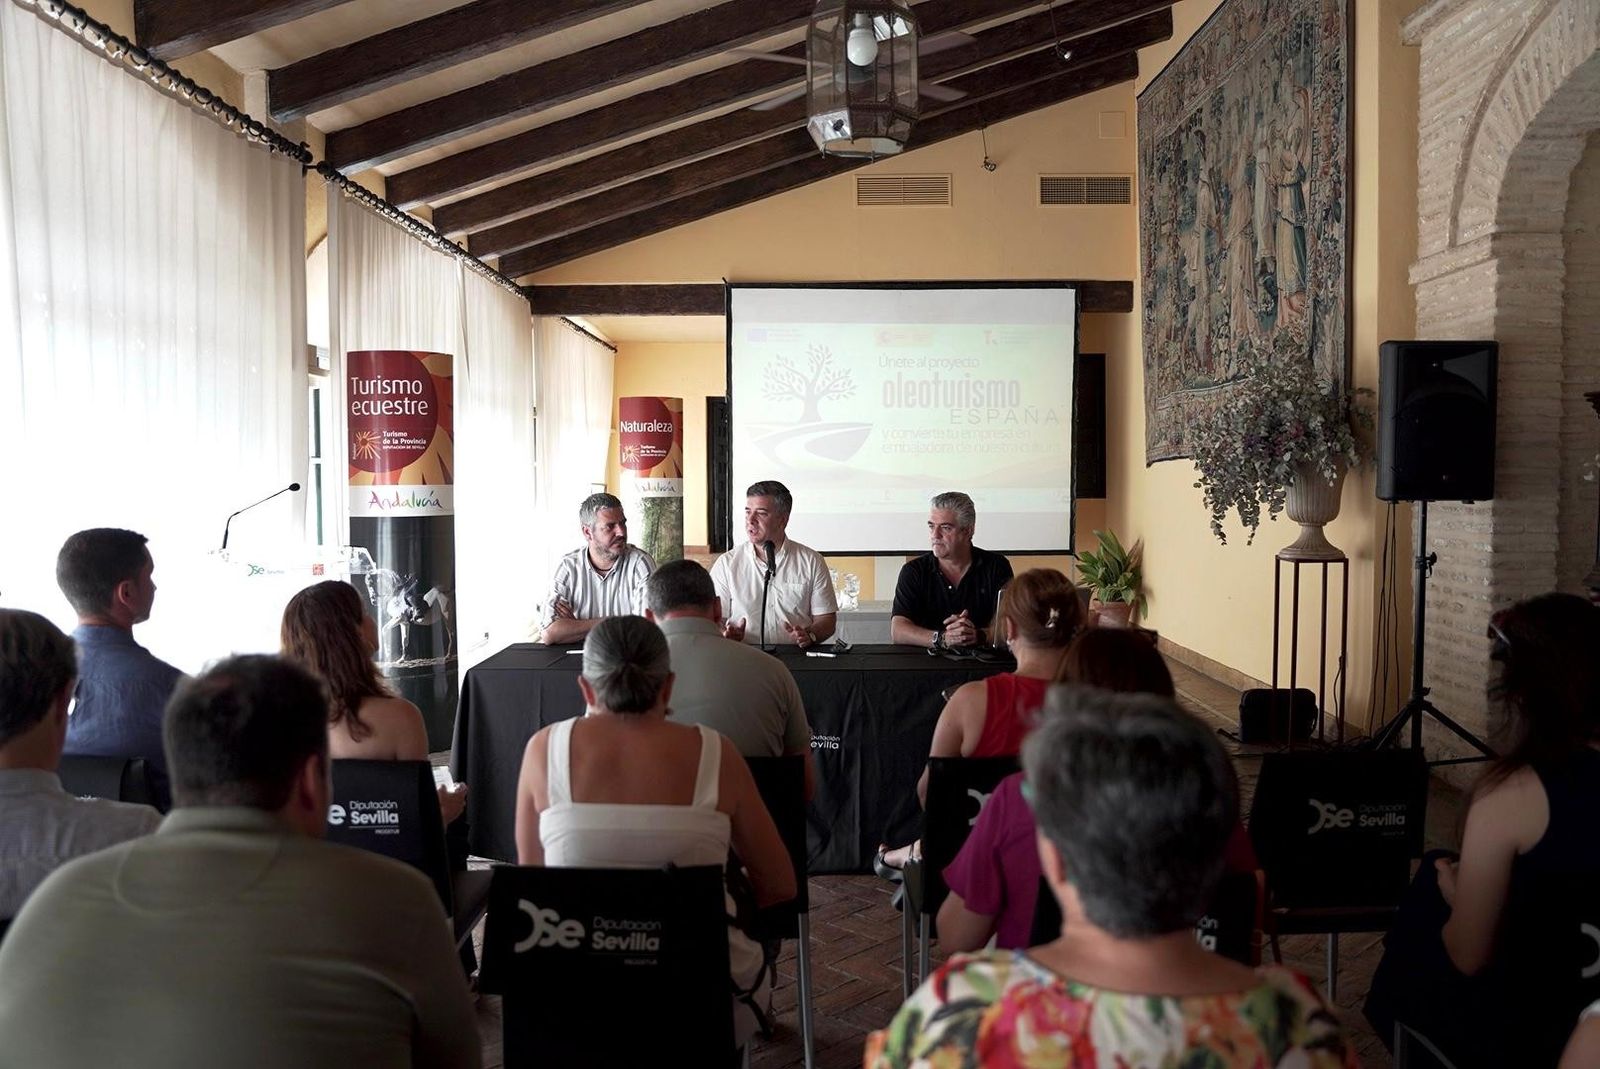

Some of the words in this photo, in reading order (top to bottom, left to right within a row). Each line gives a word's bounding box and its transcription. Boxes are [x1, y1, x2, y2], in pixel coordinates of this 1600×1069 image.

[878, 352, 915, 368] Únete
[916, 355, 927, 368] al
[928, 356, 981, 371] proyecto
[351, 375, 423, 395] Turismo
[882, 372, 1021, 409] oleoturismo
[351, 397, 429, 416] ecuestre
[950, 405, 1060, 425] ESPAÑA
[620, 419, 673, 433] Naturaleza
[382, 437, 391, 445] de
[400, 437, 427, 445] Provincia
[368, 490, 443, 510] Andalucía
[810, 734, 841, 742] putación
[810, 741, 840, 750] evilla
[349, 800, 398, 811] Diputación
[350, 810, 399, 825] Sevilla
[1359, 813, 1406, 827] Sevilla
[593, 916, 662, 931] Diputación
[592, 931, 660, 951] Sevilla
